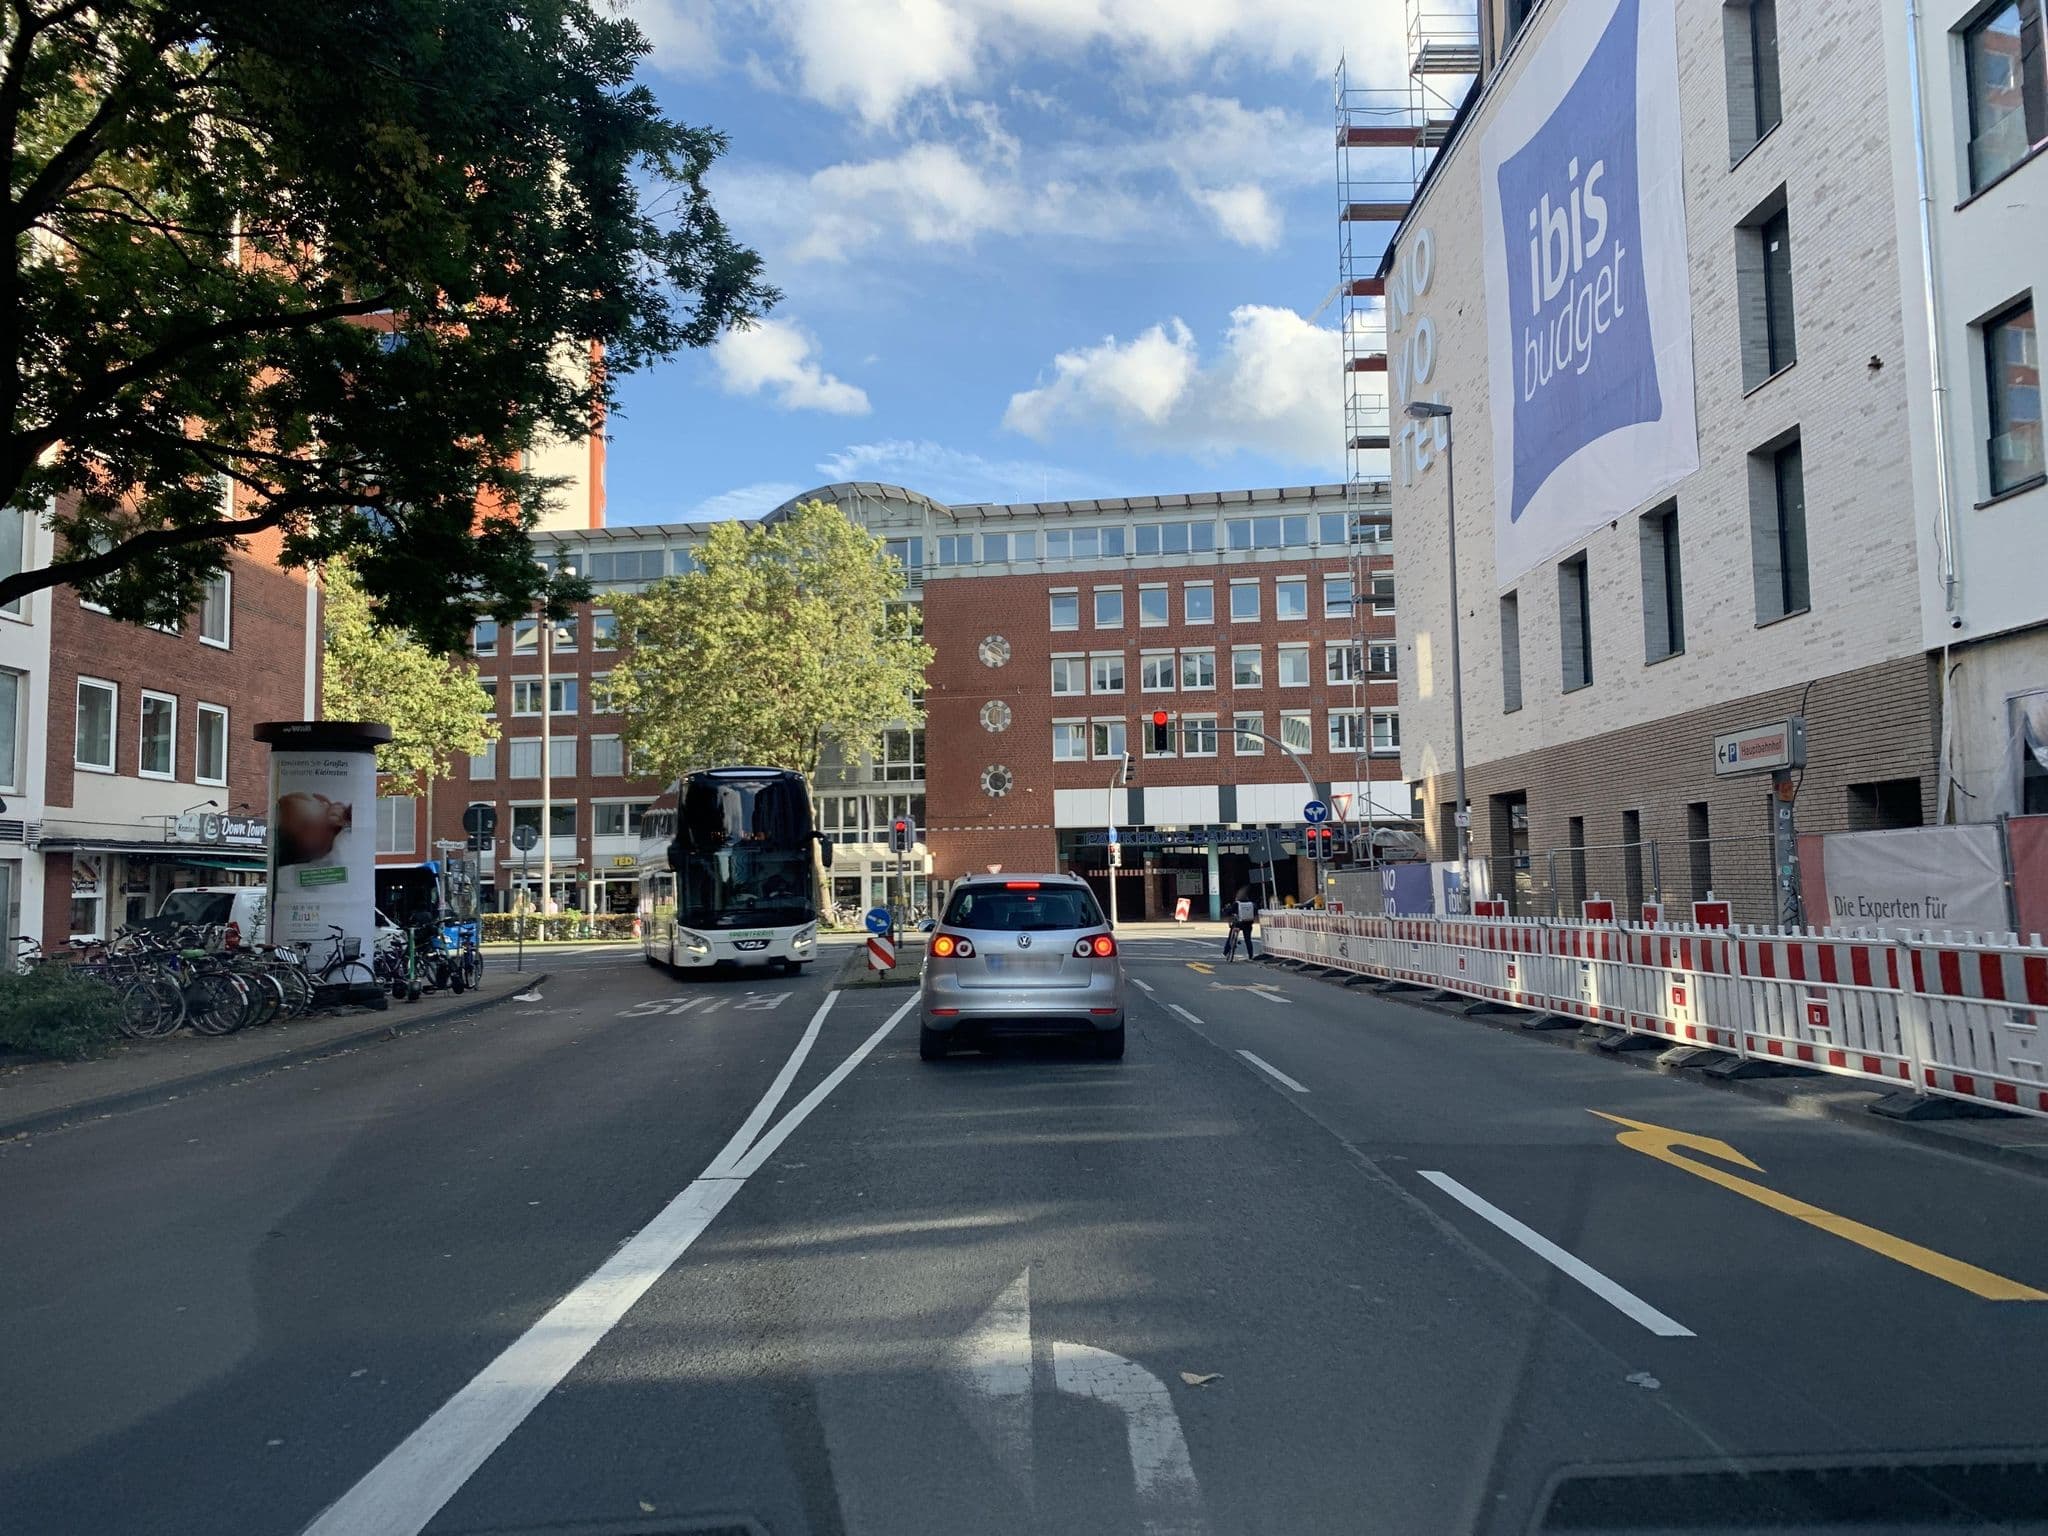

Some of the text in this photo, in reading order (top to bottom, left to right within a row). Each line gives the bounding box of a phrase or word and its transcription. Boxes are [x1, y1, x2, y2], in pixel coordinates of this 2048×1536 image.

[1529, 156, 1608, 316] ibis
[1391, 227, 1436, 333] NO
[1525, 239, 1626, 402] budget
[1395, 315, 1437, 406] VO
[1741, 740, 1782, 757] Hauptbahnhof
[222, 817, 246, 836] Down
[247, 820, 267, 837] Town
[1382, 869, 1396, 891] NO
[1834, 895, 1948, 924] Die Experten für
[738, 941, 766, 949] VDL
